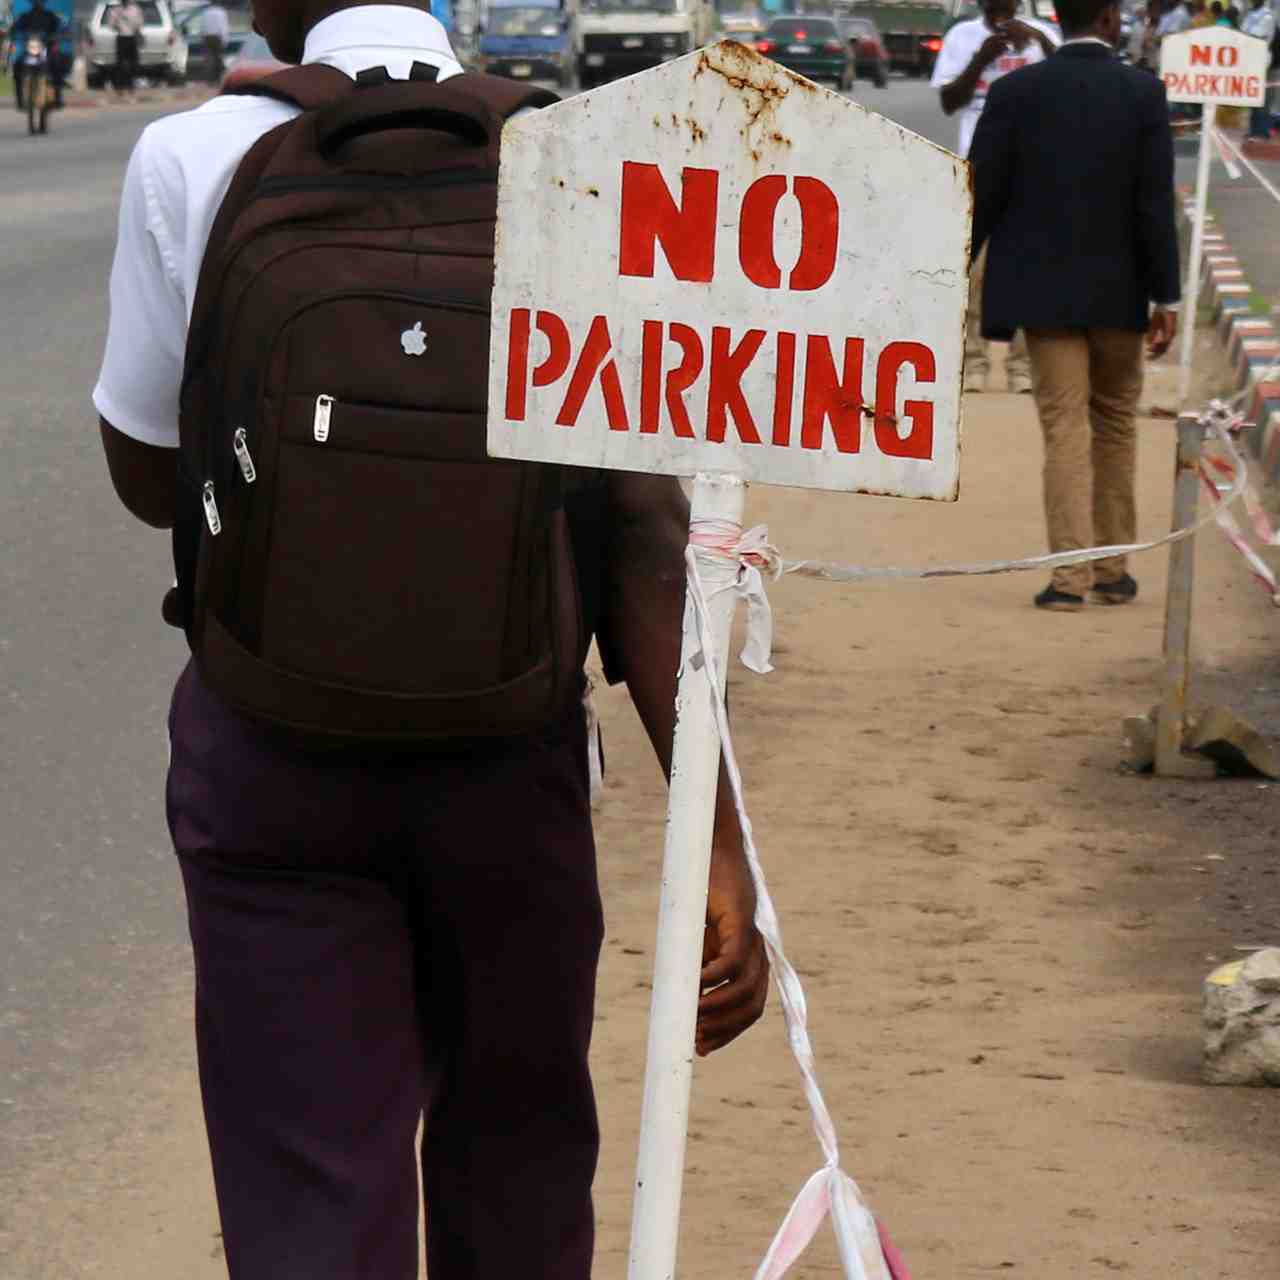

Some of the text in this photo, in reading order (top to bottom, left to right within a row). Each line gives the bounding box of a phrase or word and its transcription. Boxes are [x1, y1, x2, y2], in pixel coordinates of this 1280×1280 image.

[1163, 73, 1260, 97] PARKING
[1190, 44, 1238, 67] NO
[619, 160, 840, 292] NO
[504, 306, 937, 460] PARKING
